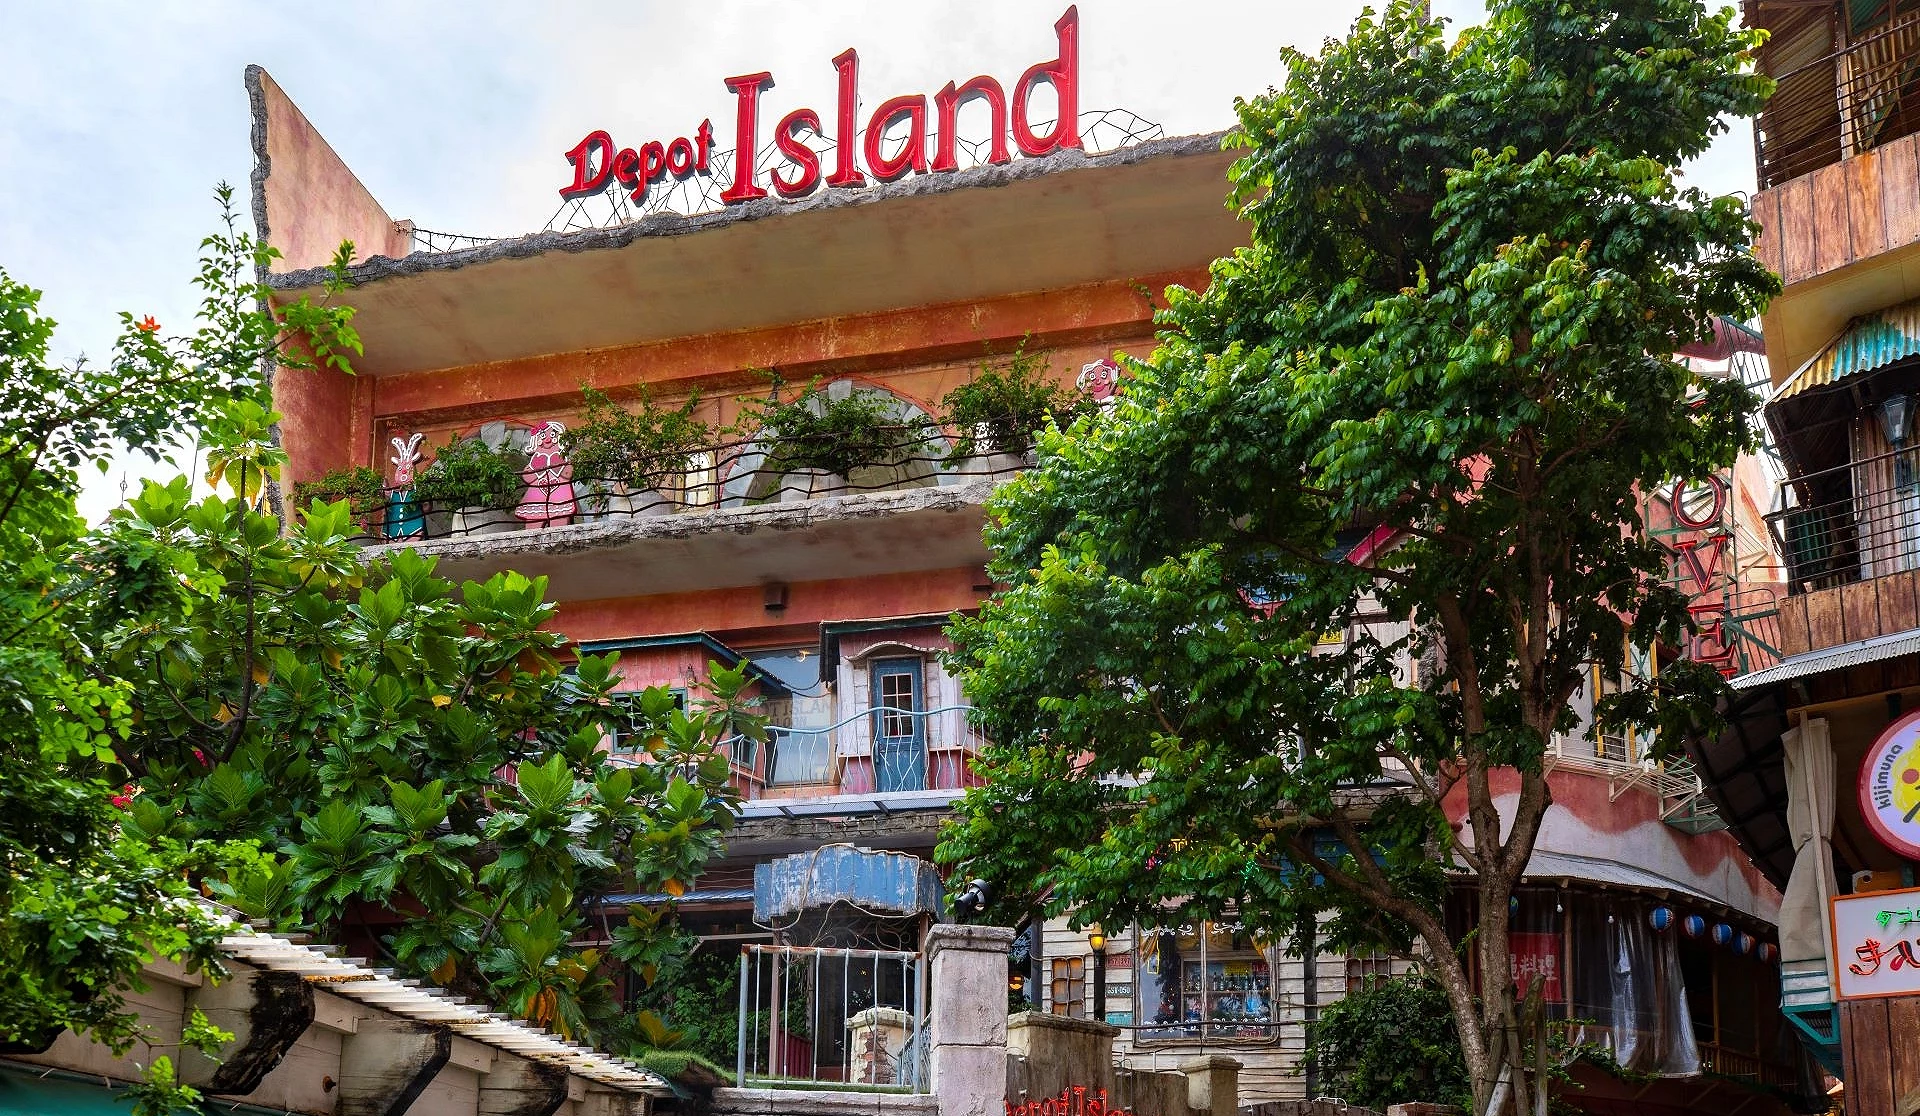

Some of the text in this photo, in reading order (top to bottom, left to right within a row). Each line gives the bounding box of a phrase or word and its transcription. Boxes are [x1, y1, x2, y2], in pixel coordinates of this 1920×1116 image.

[560, 3, 1084, 206] Depot Island
[1668, 468, 1738, 681] OVE
[1873, 744, 1904, 810] kijimuna
[1876, 909, 1920, 927] タコ
